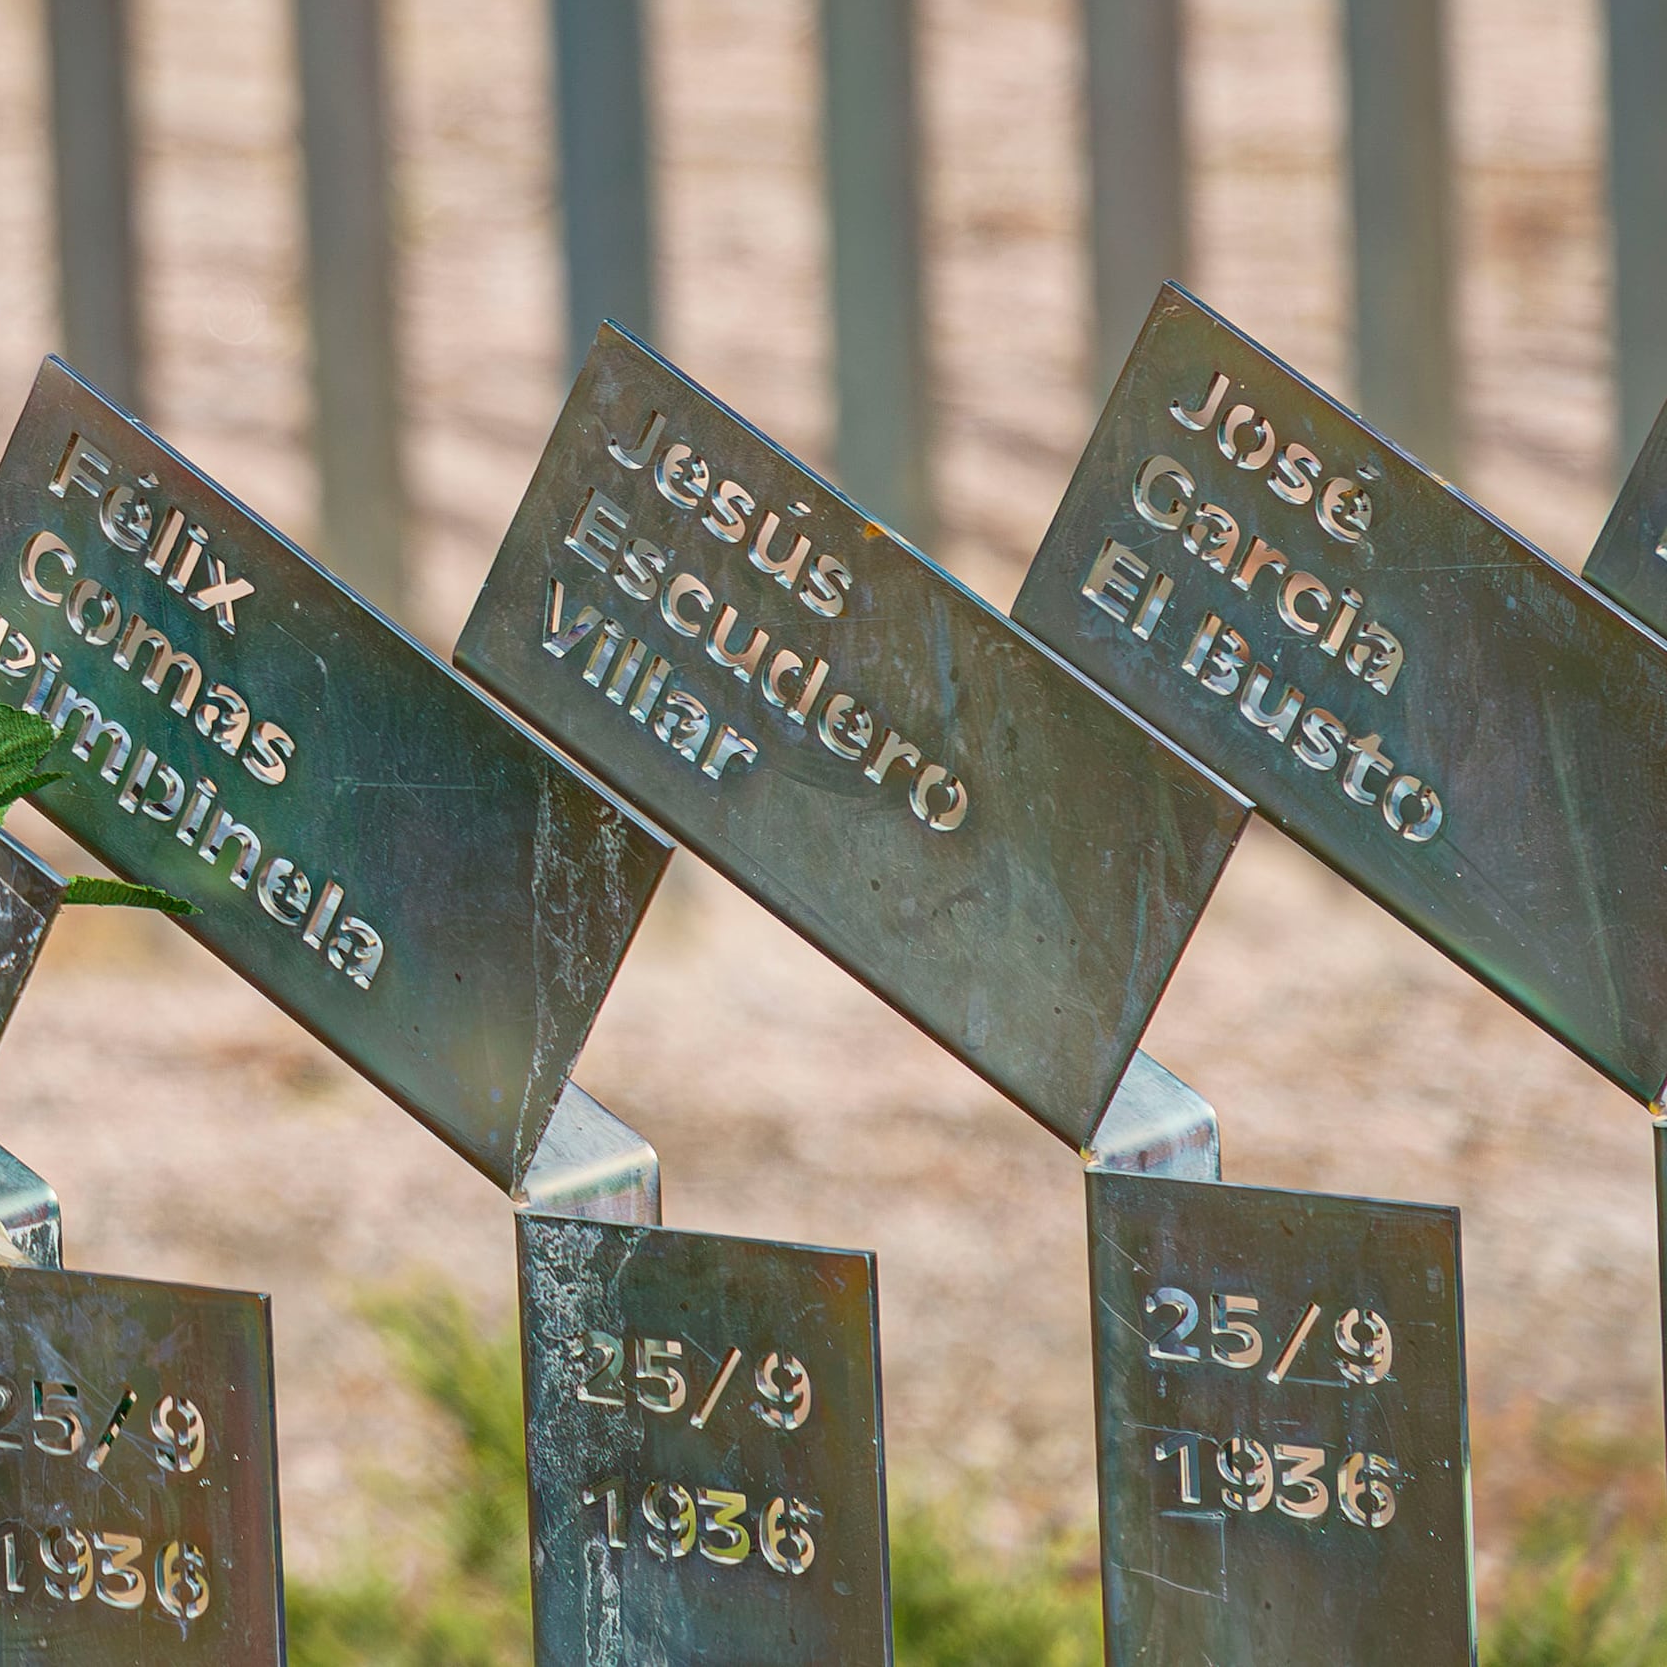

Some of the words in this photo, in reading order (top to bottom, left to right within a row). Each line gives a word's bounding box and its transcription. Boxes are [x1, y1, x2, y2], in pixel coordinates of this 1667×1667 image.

[47, 431, 256, 634] Félix
[607, 409, 853, 618] Jesús
[1169, 370, 1383, 544] José
[19, 529, 297, 785] Comas
[542, 577, 758, 781] Villar
[564, 486, 968, 832] Escudero
[1081, 537, 1174, 641] El
[1181, 610, 1444, 843] Busto
[575, 1330, 813, 1430] 25/9
[1146, 1287, 1395, 1385] 25/9
[582, 1476, 819, 1576] 1936
[1155, 1430, 1398, 1529] 1936
